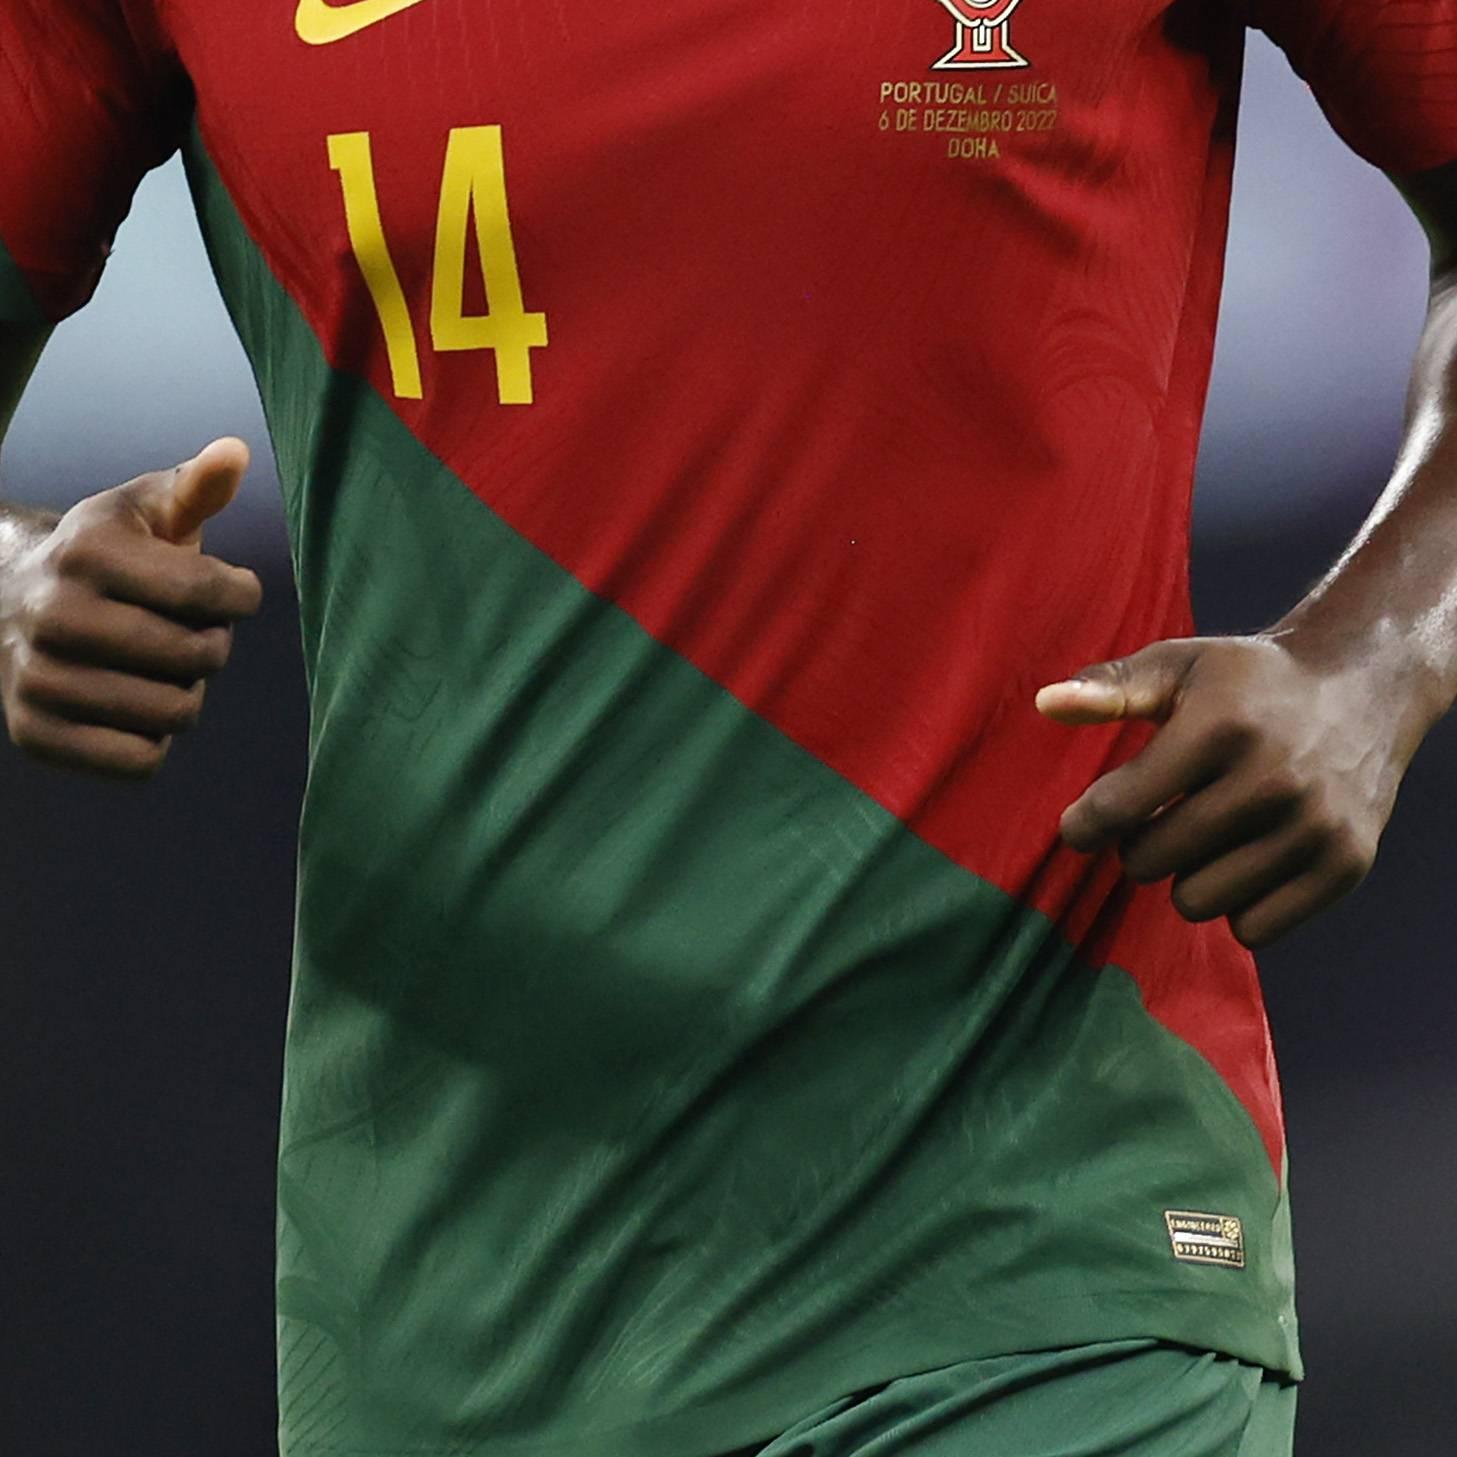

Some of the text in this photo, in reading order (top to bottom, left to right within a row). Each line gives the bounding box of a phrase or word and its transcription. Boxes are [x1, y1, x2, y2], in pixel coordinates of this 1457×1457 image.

[880, 81, 987, 104] PORTUGAL
[993, 84, 1003, 104] /
[879, 109, 1057, 133] 6 DE DEZEMBRO 2022
[948, 137, 1000, 159] DOHA
[326, 124, 548, 405] 14
